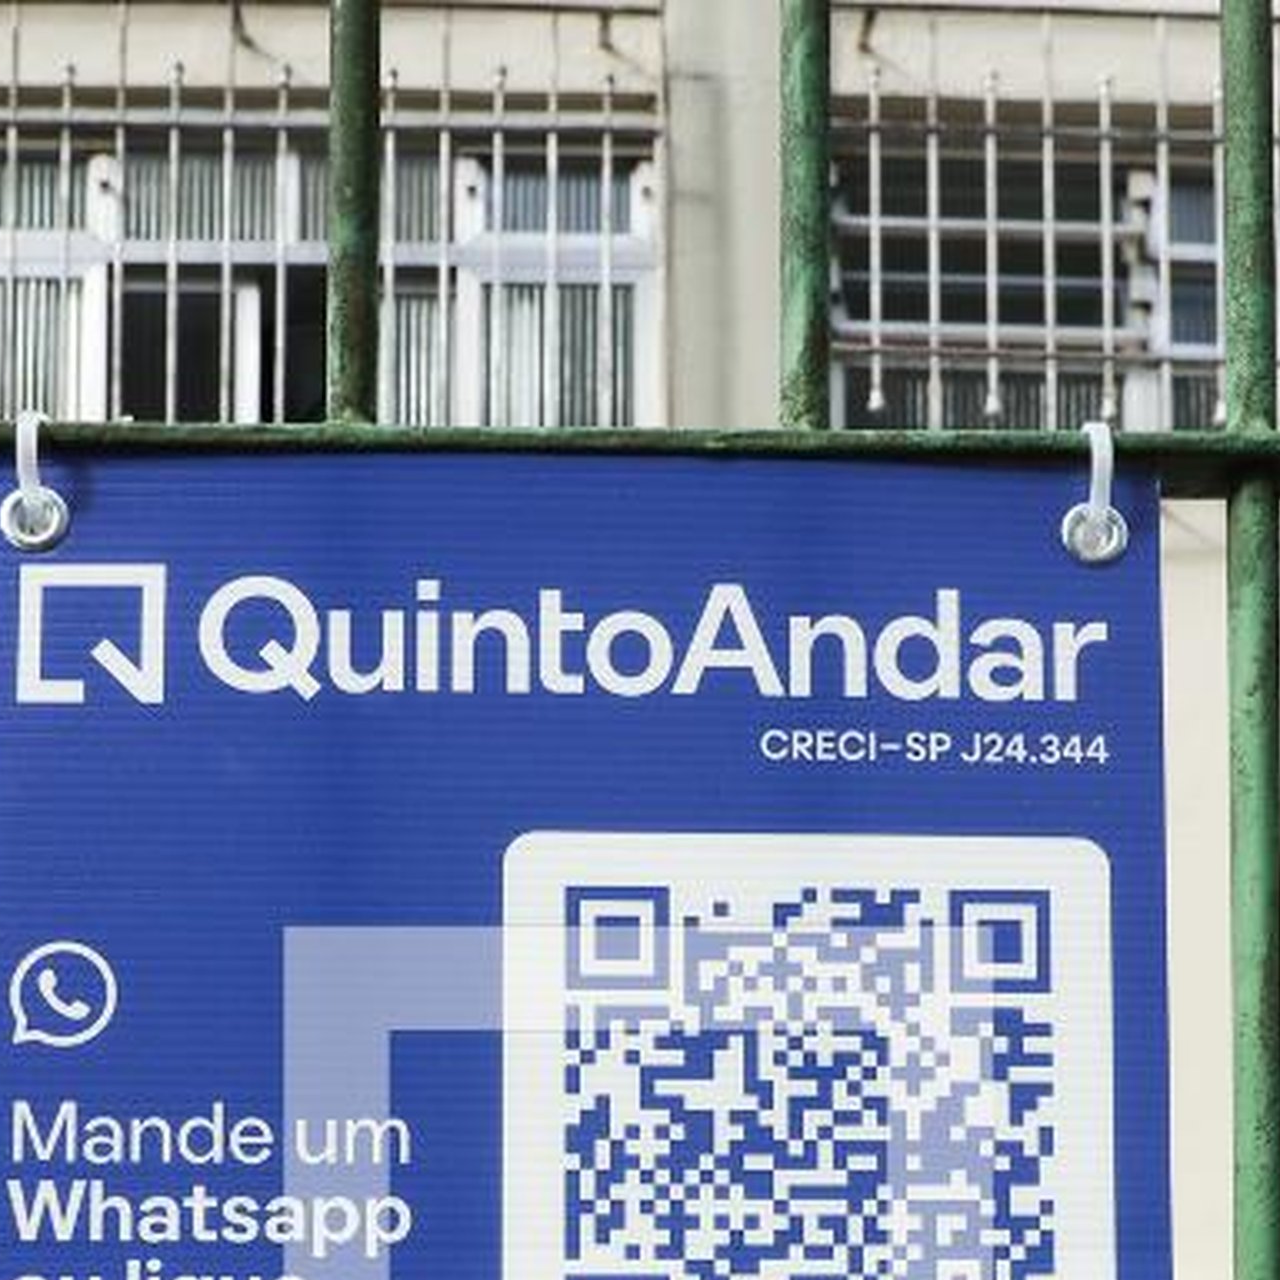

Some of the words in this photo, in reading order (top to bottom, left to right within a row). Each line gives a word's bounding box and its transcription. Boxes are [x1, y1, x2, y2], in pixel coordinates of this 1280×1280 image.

[198, 574, 1110, 702] QuintoAndar
[759, 729, 951, 762] CRECI-SP
[960, 731, 1110, 765] J24.344
[11, 1100, 274, 1165] Mande
[293, 1115, 412, 1165] um
[6, 1178, 413, 1258] Whatsapp
